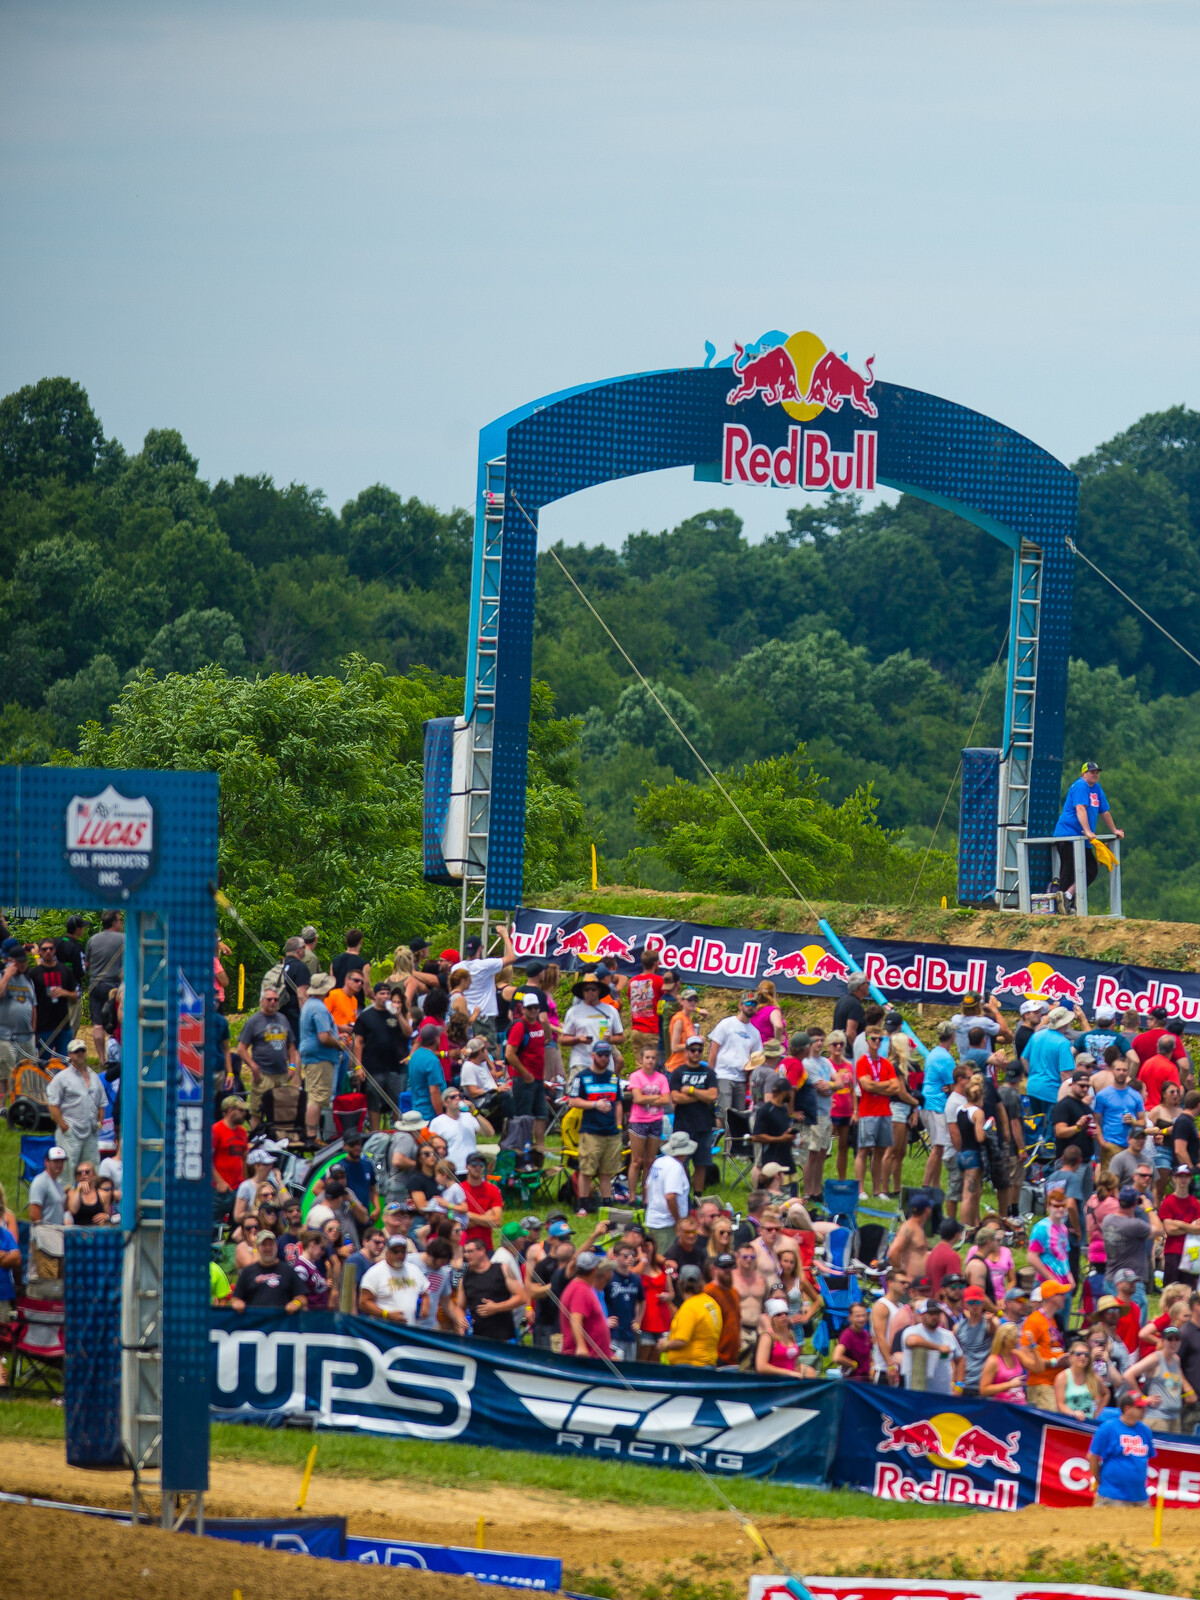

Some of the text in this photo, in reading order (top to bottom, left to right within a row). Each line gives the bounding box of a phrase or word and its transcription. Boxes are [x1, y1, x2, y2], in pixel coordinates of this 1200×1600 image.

[77, 821, 149, 846] LUCAS
[70, 852, 149, 870] OIL PRODUCTS
[511, 921, 552, 957] ull
[177, 966, 206, 1104] AMA
[681, 1074, 707, 1085] FOX
[186, 1106, 203, 1180] PRO
[210, 1329, 478, 1440] WPS
[495, 1369, 821, 1454] FLY
[556, 1437, 744, 1471] RACING
